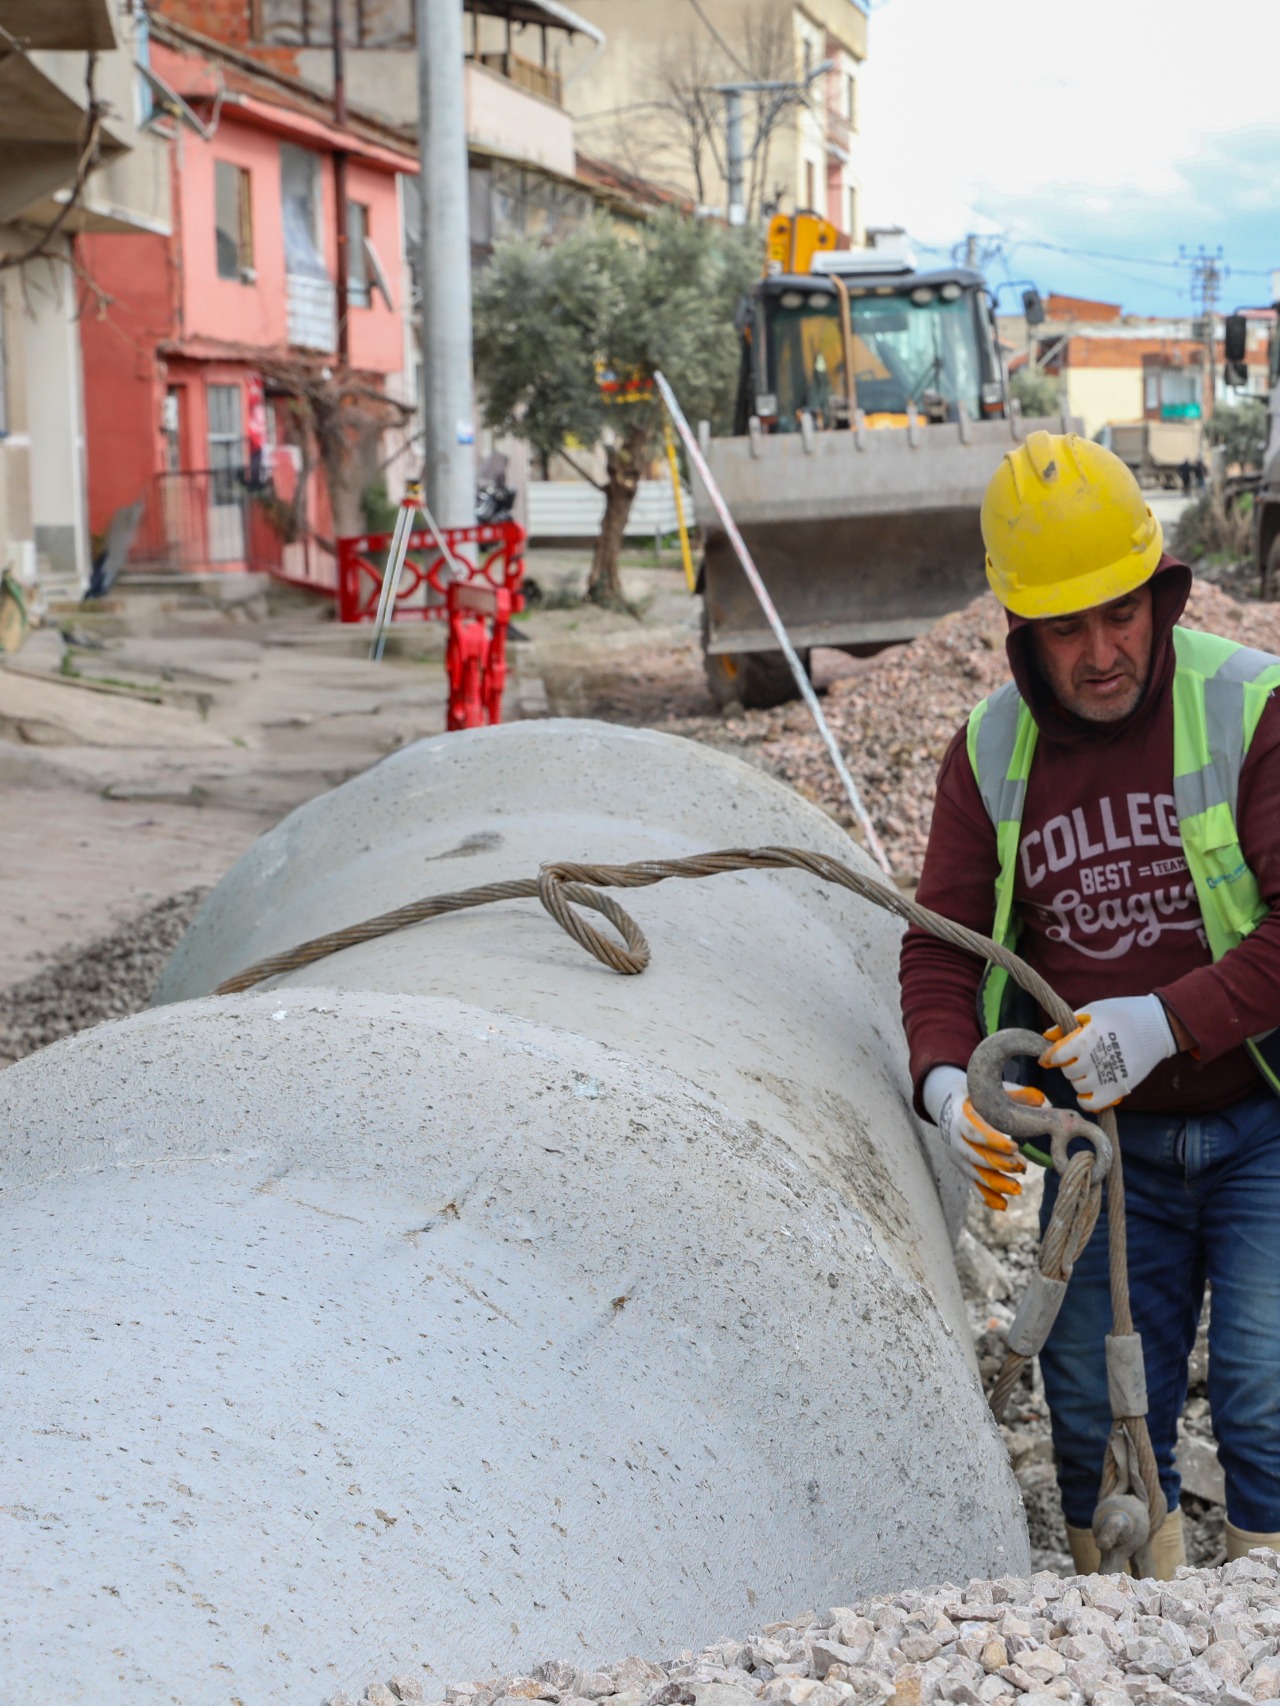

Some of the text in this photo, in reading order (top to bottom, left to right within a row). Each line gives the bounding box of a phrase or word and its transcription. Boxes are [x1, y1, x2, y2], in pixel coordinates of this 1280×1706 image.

[1079, 858, 1188, 896] BEST TEAM
[1108, 1032, 1128, 1078] DEMIR
